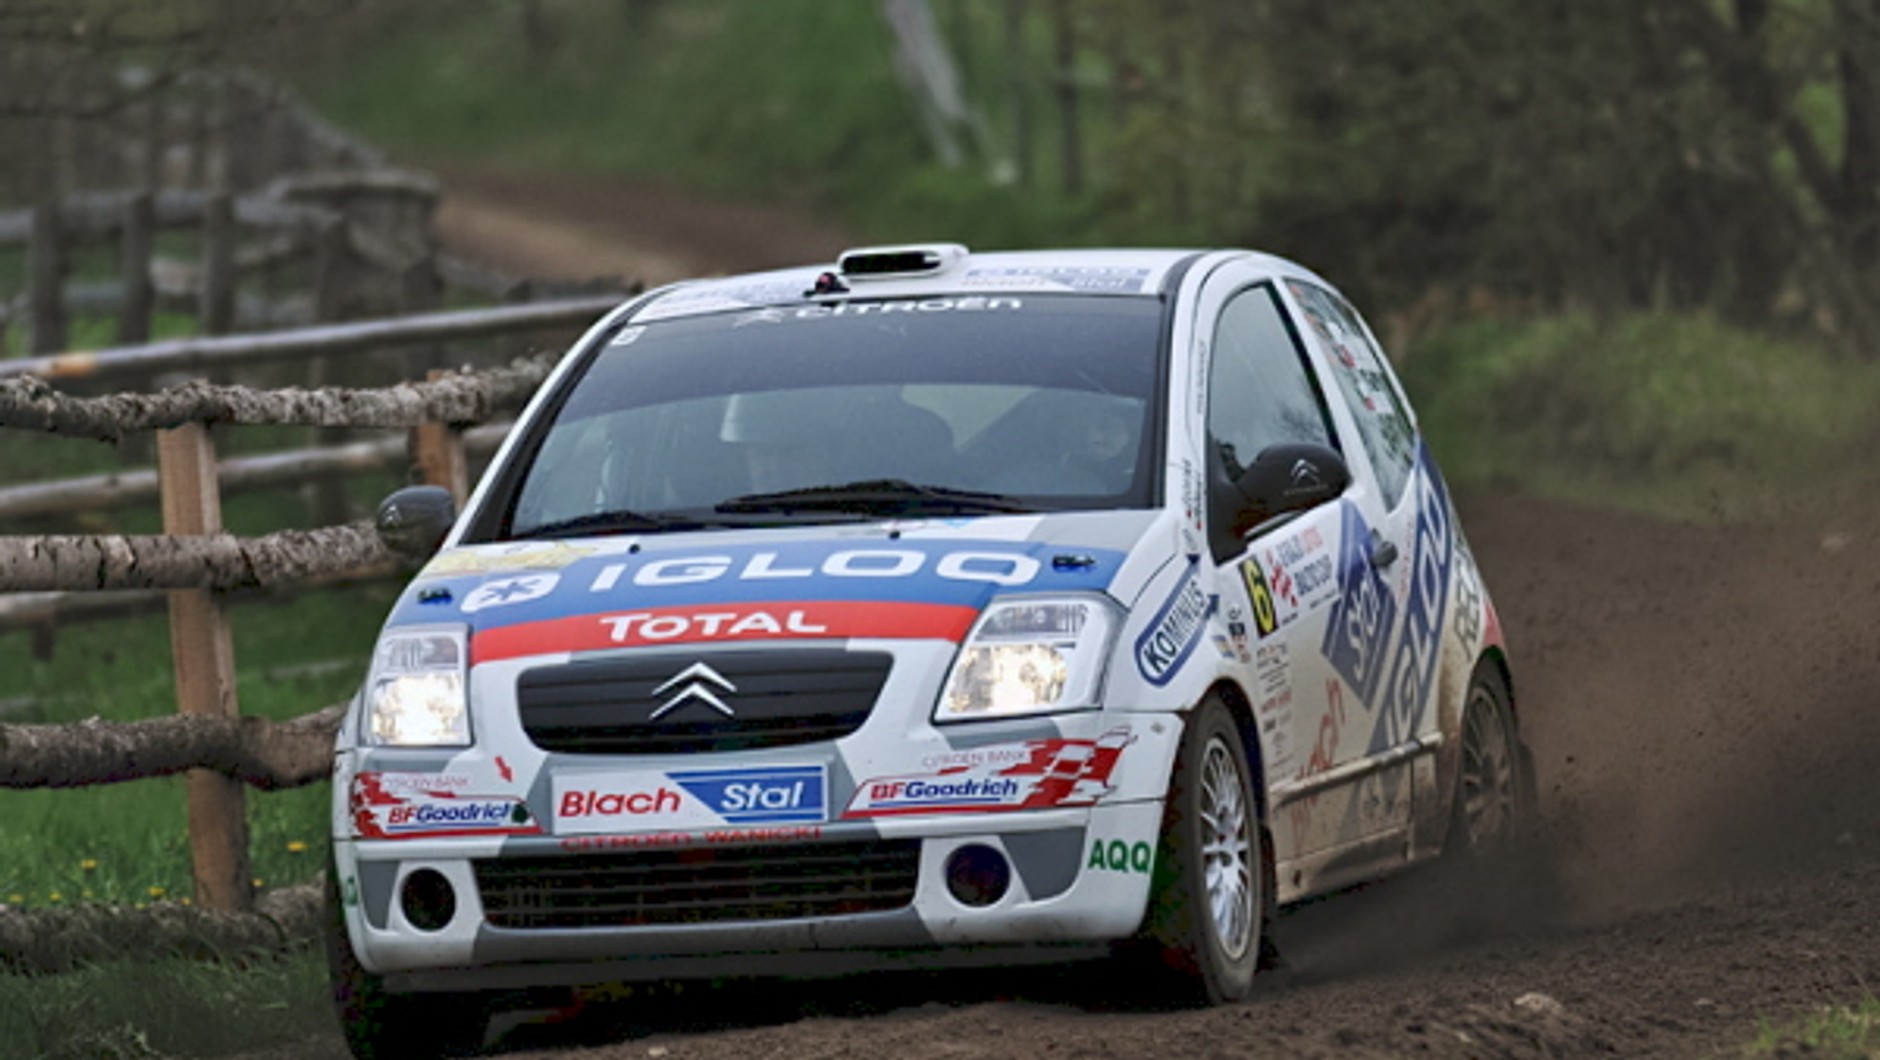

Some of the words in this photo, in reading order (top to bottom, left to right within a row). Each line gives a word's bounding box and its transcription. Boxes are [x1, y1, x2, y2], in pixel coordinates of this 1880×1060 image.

[1246, 558, 1273, 633] 6
[599, 610, 828, 642] TOTAL
[559, 787, 682, 818] Blach
[720, 781, 805, 811] Stal
[870, 777, 1019, 801] BFGoodrich
[1087, 837, 1152, 874] AQQ
